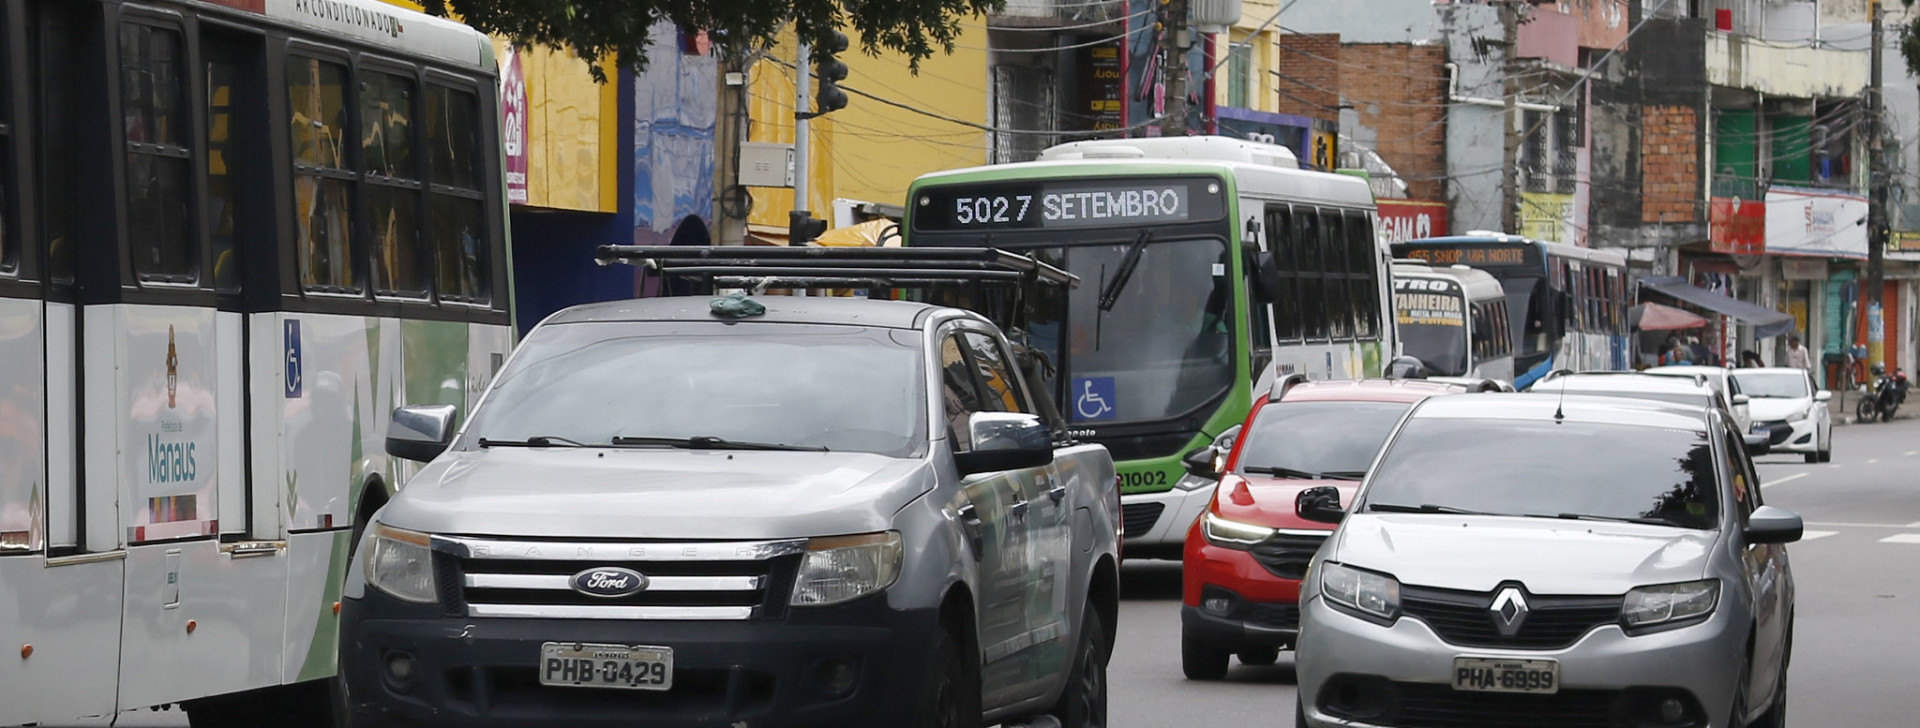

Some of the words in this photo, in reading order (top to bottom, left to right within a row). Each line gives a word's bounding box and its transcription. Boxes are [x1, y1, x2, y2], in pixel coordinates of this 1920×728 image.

[311, 0, 391, 34] CONDICIONADO
[1043, 189, 1179, 220] SETEMBRO
[1434, 248, 1463, 264] SHOP
[1488, 248, 1524, 265] NORTE
[148, 433, 196, 484] Manaus
[474, 544, 756, 558] RANGER
[587, 571, 628, 589] Ford
[546, 658, 666, 685] PHB-0429
[1457, 667, 1554, 689] PHA-6999
